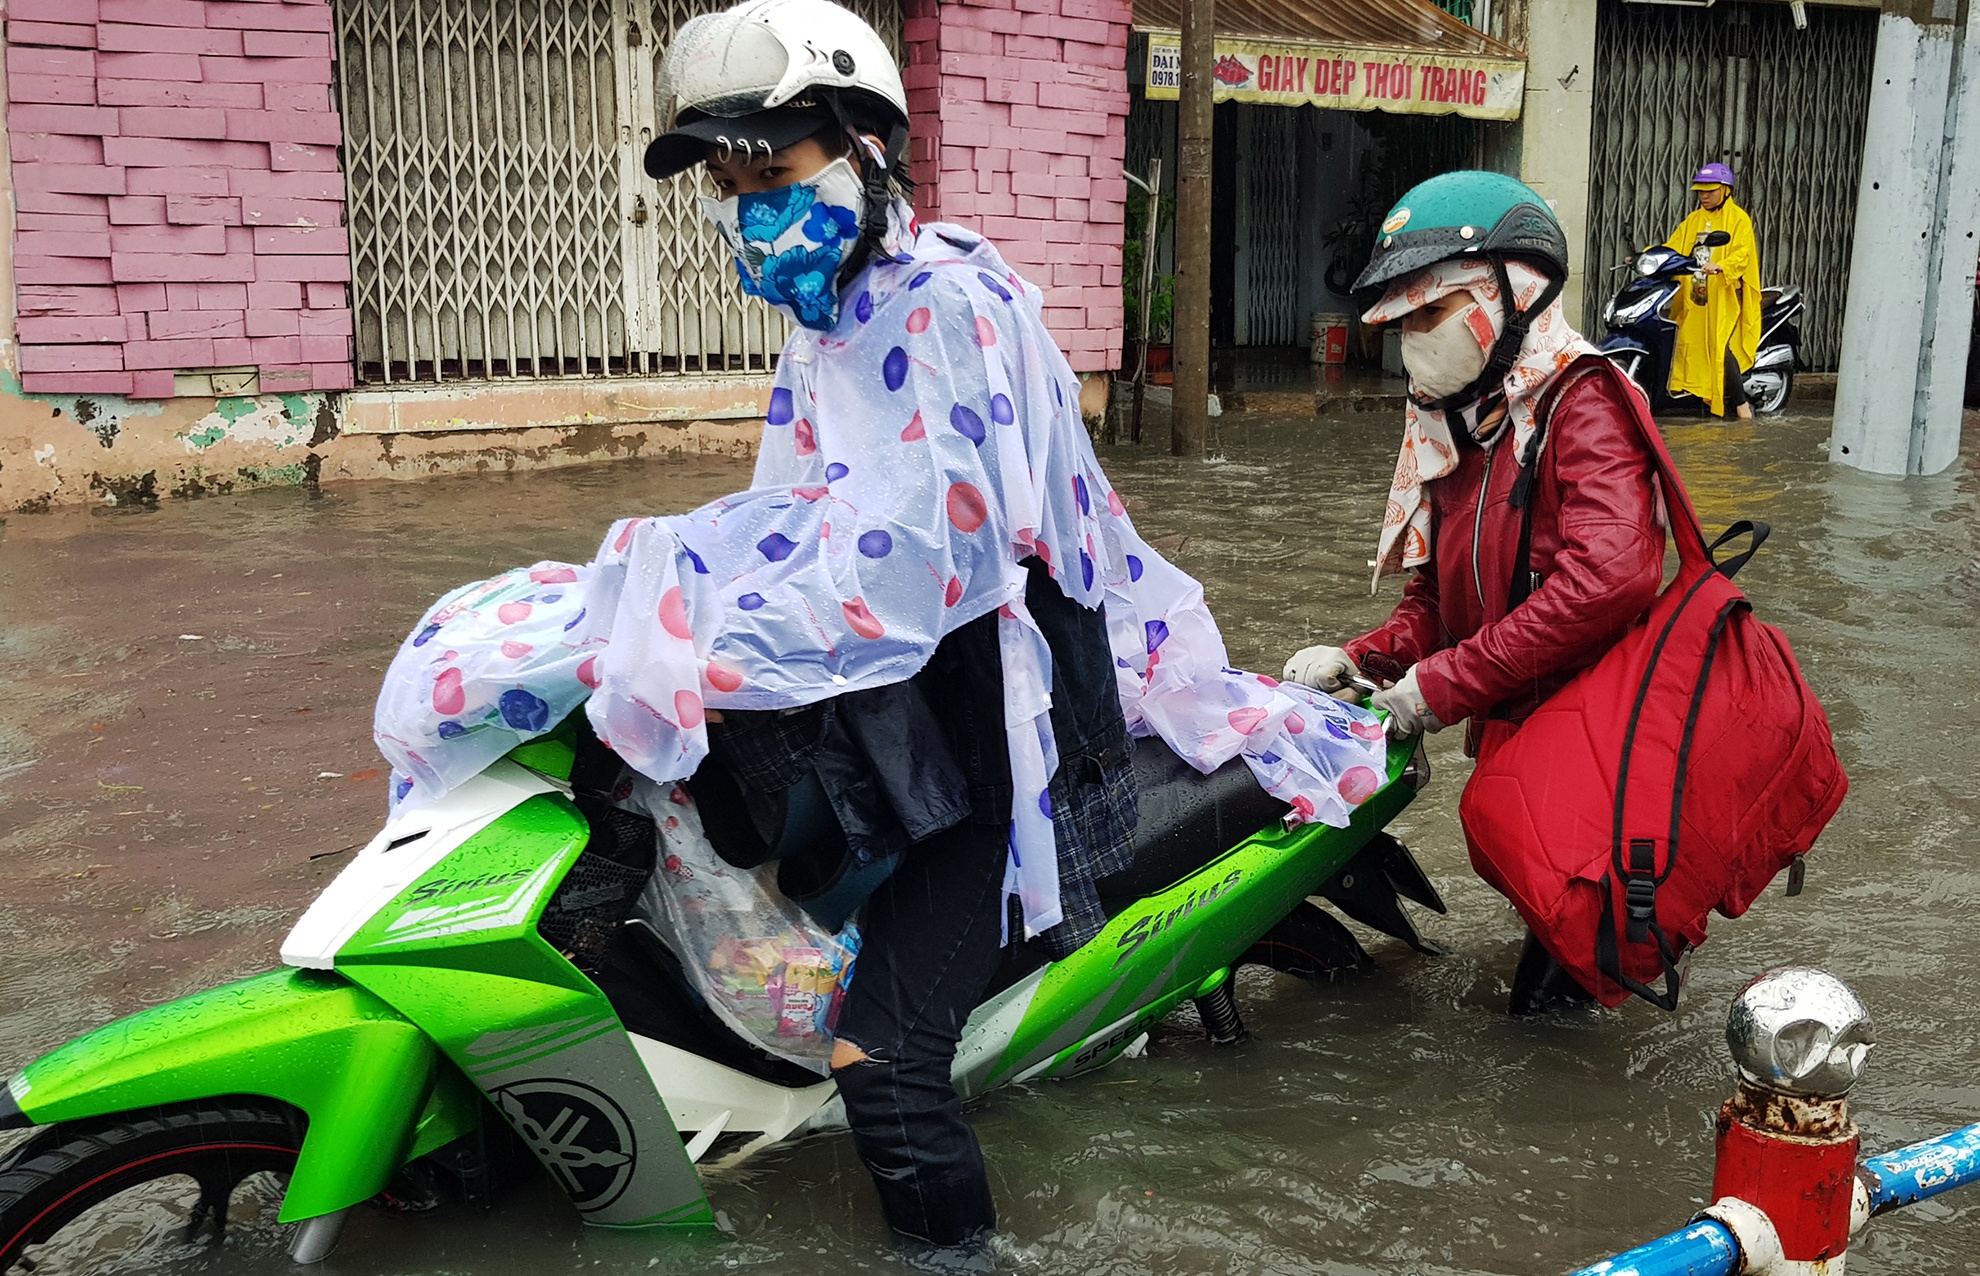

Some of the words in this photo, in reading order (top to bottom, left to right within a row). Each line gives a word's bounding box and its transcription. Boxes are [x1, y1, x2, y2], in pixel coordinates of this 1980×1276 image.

[1258, 50, 1309, 93] GIÀY
[1313, 53, 1357, 97] DÉP
[1363, 58, 1413, 100] THỜI
[1420, 65, 1487, 106] TRANG
[1522, 216, 1543, 233] 3G
[402, 868, 533, 908] Sirius
[1112, 869, 1242, 971] Sirius
[1073, 1014, 1155, 1069] SPEED
